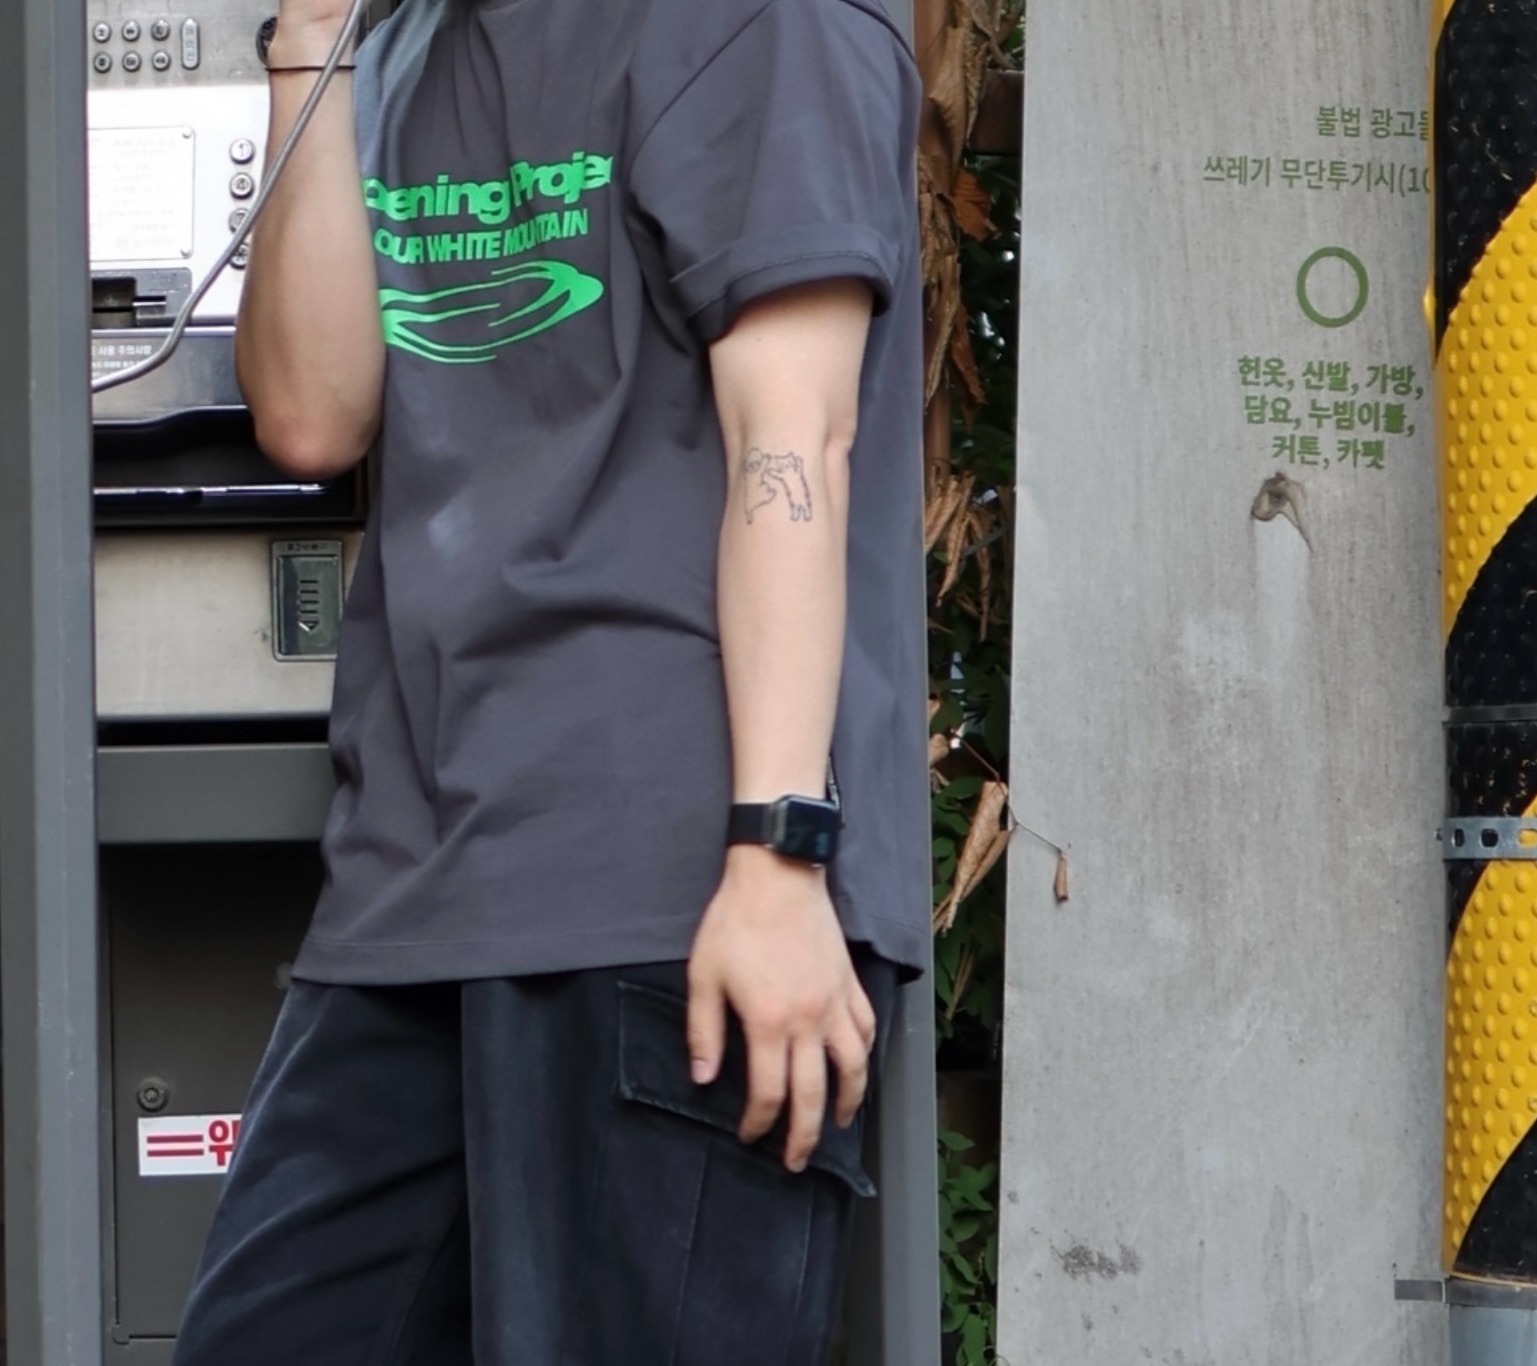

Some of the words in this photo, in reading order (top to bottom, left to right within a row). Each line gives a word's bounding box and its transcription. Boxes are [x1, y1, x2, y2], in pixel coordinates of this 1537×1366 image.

[1316, 105, 1362, 137] 불법
[1202, 156, 1271, 188] 쓰레기
[426, 230, 501, 262] WHITE
[503, 208, 588, 256] MOUNTAIN
[1237, 354, 1295, 392] 헌옷,
[1302, 360, 1360, 395] 신발,
[1366, 364, 1425, 400] 가방,
[1244, 394, 1302, 431] 담요,
[1271, 434, 1330, 470] 커튼,
